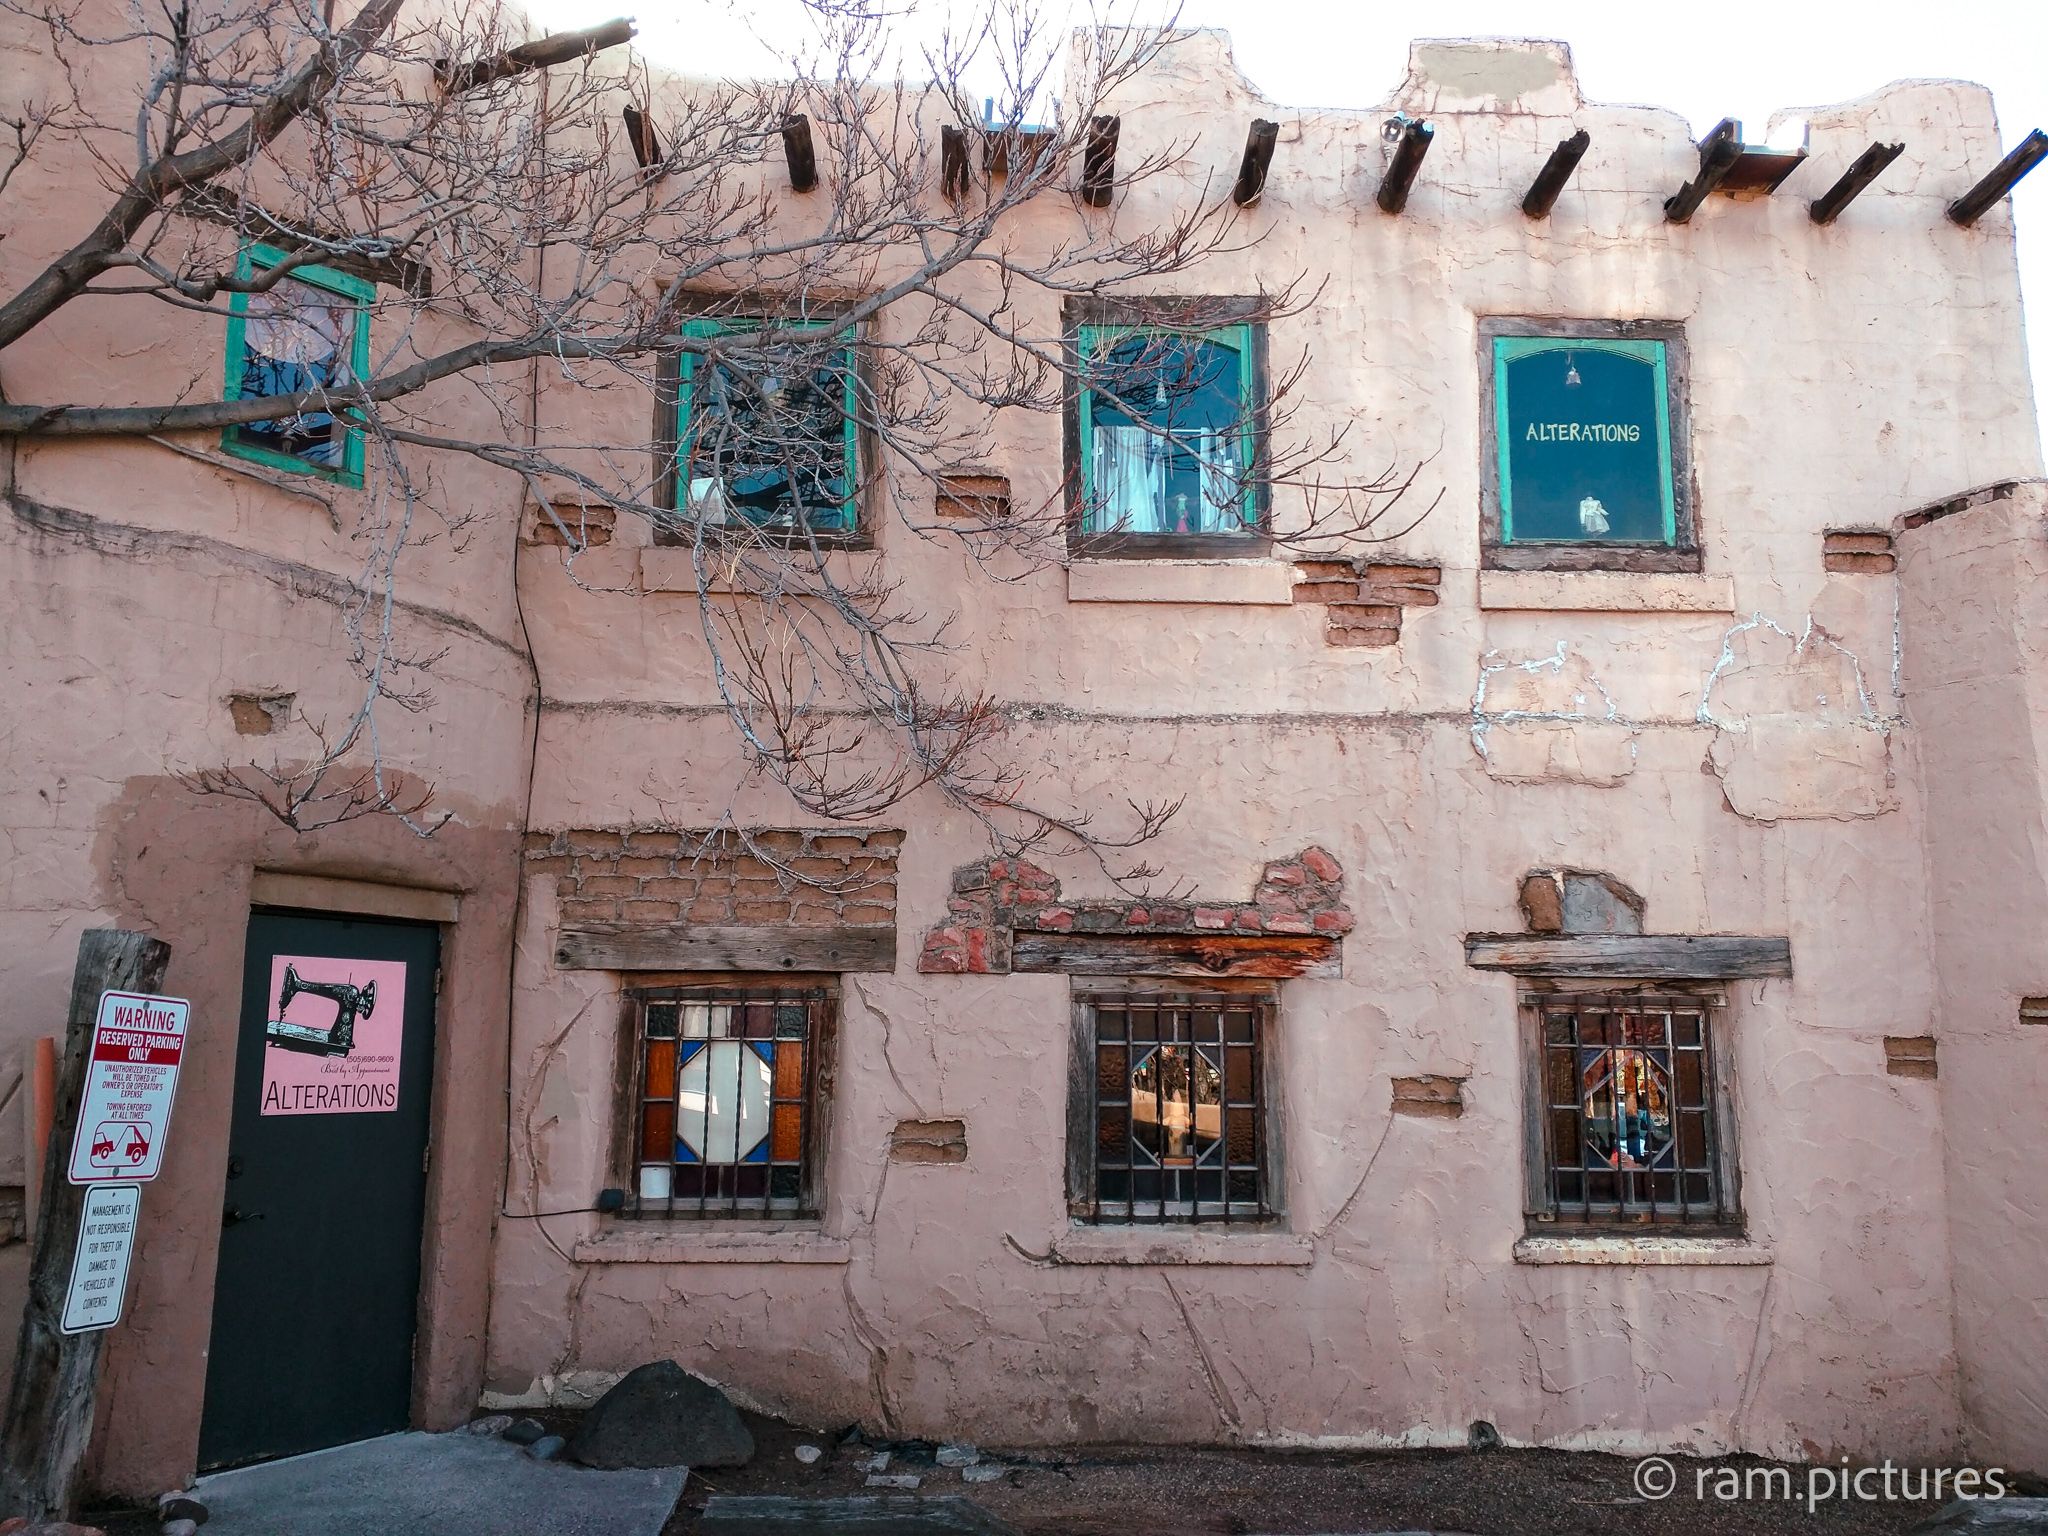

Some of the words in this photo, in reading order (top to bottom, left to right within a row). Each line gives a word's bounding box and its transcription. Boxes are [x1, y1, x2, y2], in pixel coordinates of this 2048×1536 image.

[1526, 423, 1640, 442] ALTERATIONS
[114, 1006, 175, 1030] WARNING
[100, 1031, 143, 1047] RESERVED
[145, 1035, 181, 1050] PARKING
[128, 1047, 150, 1061] ONLY
[105, 1065, 143, 1074] UNAUTHORIZED
[144, 1067, 167, 1075] VEHICLES
[340, 1064, 347, 1078] by
[348, 1063, 390, 1079] Appointment
[134, 1074, 150, 1082] TOWED
[126, 1082, 133, 1090] OR
[134, 1082, 163, 1091] OPERATOR'S
[121, 1090, 143, 1098] EXPENSE
[263, 1080, 395, 1110] ALTERATIONS
[106, 1103, 126, 1111] TOWING
[127, 1103, 152, 1111] ENFORCED
[92, 1205, 125, 1216] MANAGEMENT
[125, 1204, 131, 1215] IS
[86, 1224, 97, 1235] NOT
[98, 1222, 130, 1235] RESPONSIBLE
[88, 1242, 98, 1253] FOR
[100, 1241, 114, 1253] THEFT
[115, 1241, 122, 1251] OR
[88, 1260, 108, 1272] DAMAGE
[109, 1259, 117, 1269] TO
[83, 1279, 106, 1291] VEHICLES
[107, 1277, 115, 1288] OR
[83, 1296, 107, 1309] CONTENTS
